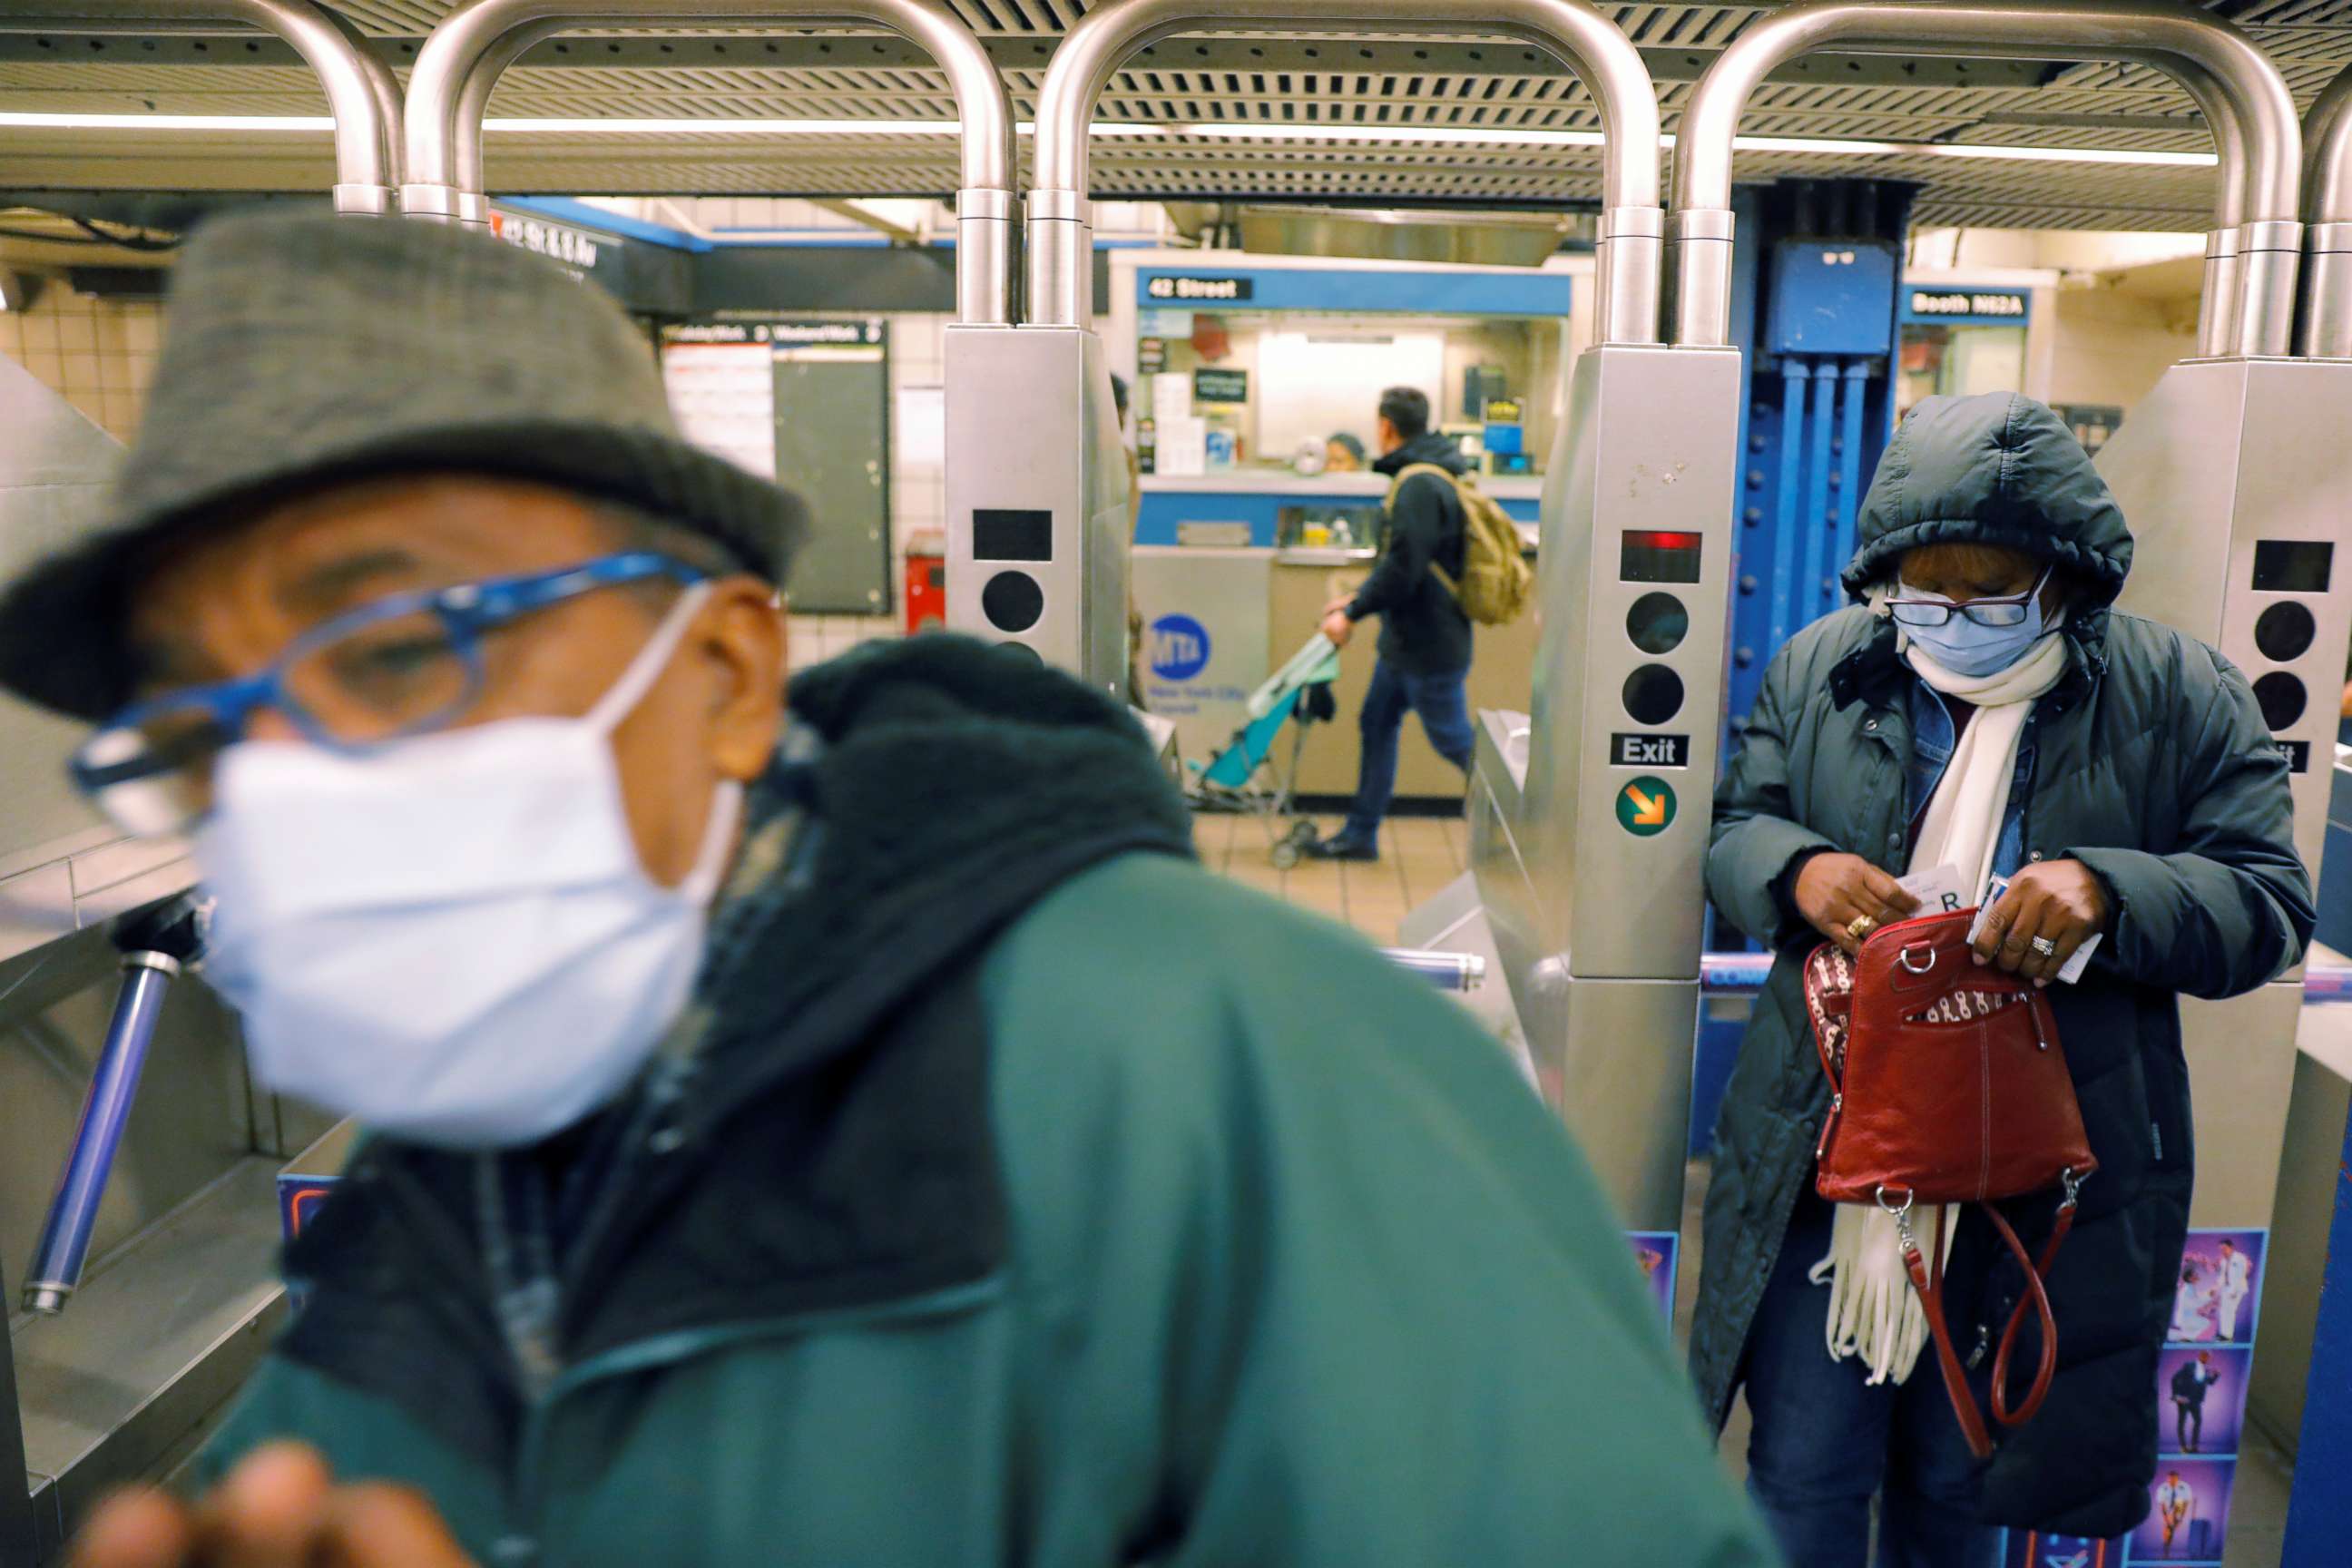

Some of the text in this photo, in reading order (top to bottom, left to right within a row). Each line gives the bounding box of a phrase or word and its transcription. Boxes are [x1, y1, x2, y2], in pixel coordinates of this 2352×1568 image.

[1148, 277, 1237, 299] 42 Street
[1912, 292, 1970, 313] Booth
[1622, 737, 1676, 763] Exit
[1941, 892, 1962, 912] R
